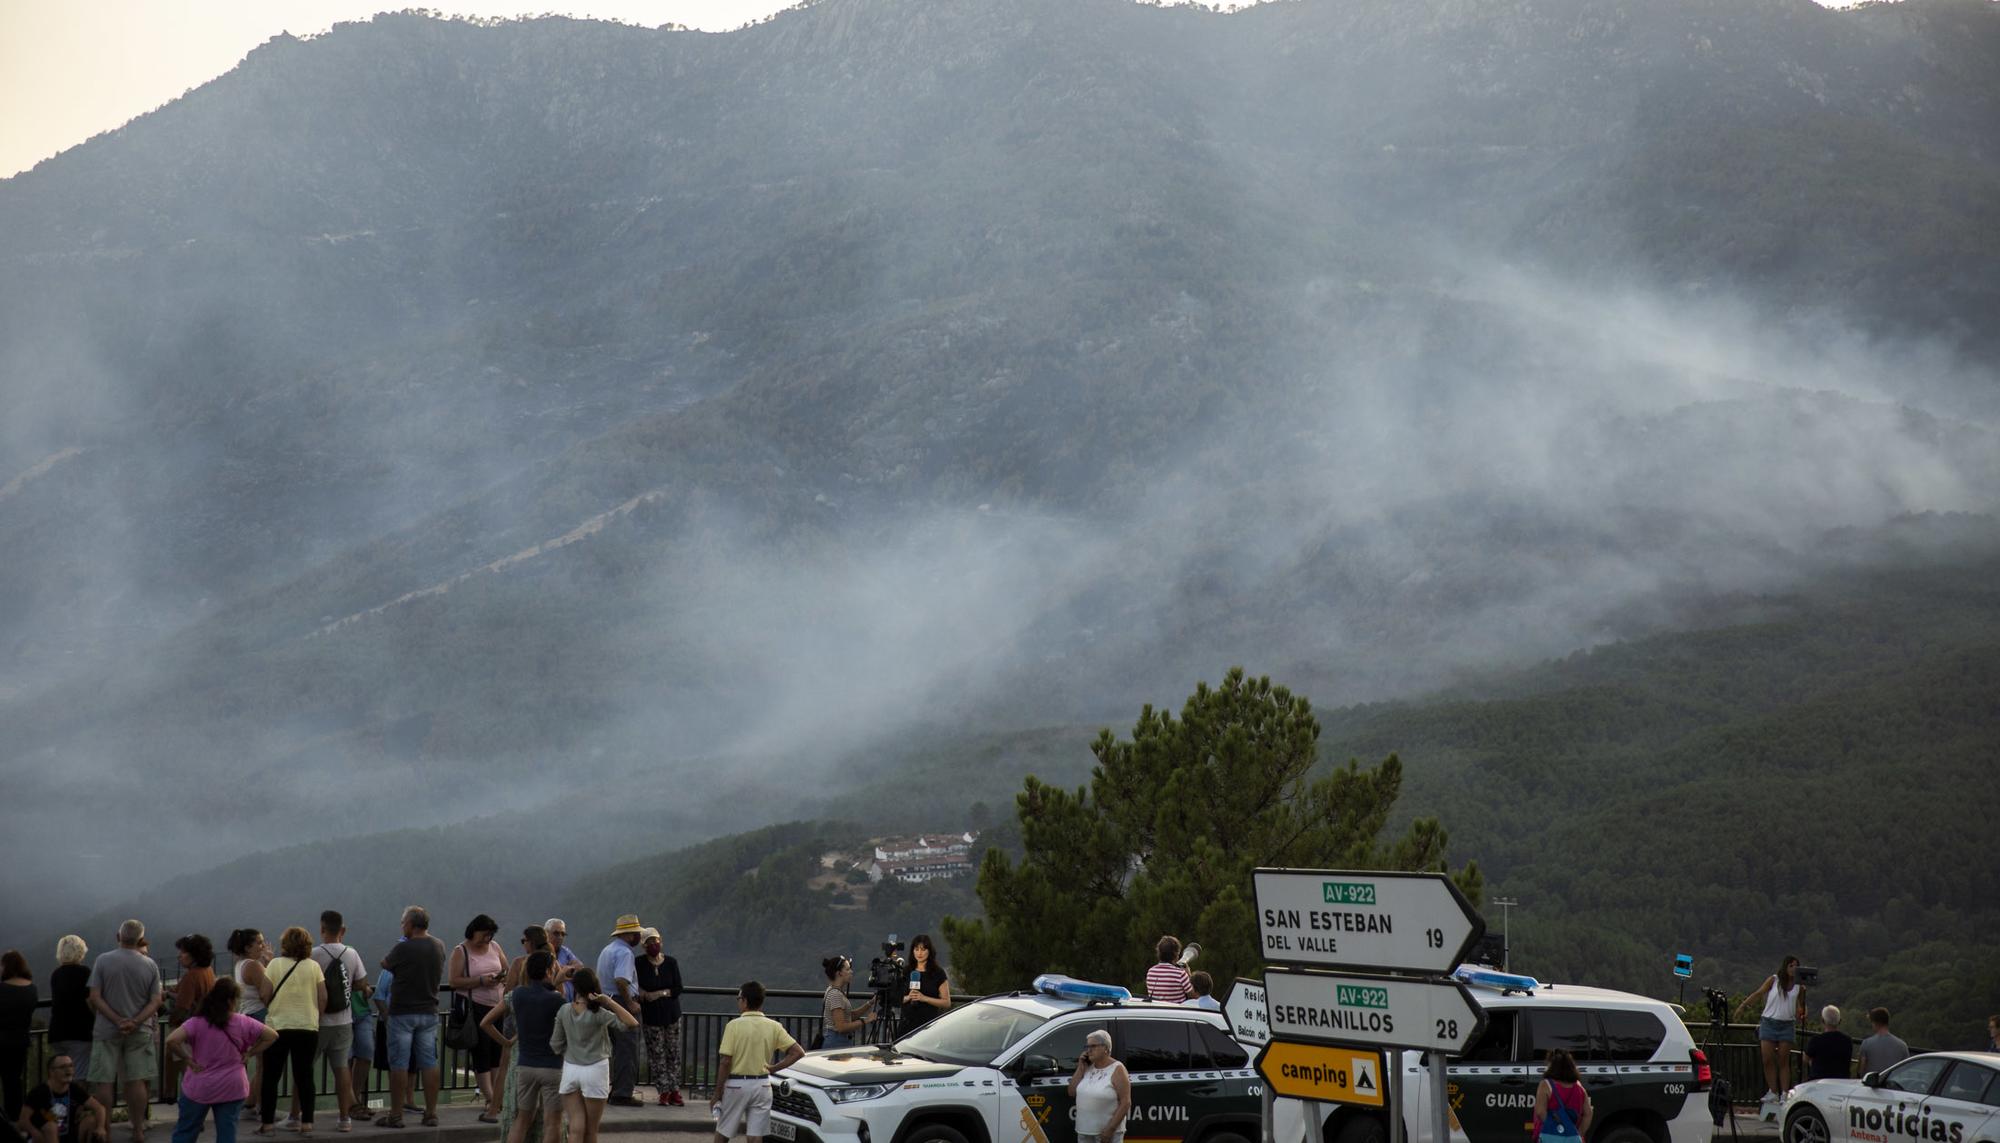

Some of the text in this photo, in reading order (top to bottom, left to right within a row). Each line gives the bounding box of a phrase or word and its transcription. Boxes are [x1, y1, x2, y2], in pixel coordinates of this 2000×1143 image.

[1325, 885, 1374, 902] AV-922
[1265, 909, 1392, 934] SAN ESTEBAN
[1267, 935, 1337, 953] DEL VALLE
[1426, 928, 1444, 949] 19
[1244, 988, 1265, 1003] Resid
[1339, 988, 1387, 1006] AV-922
[1244, 1008, 1253, 1020] de
[1275, 1005, 1394, 1033] SERRANILLOS
[1238, 1024, 1267, 1041] Balcón del
[1436, 1019, 1458, 1040] 28
[1281, 1063, 1347, 1088] camping
[1485, 1093, 1537, 1108] GUARD
[1147, 1105, 1190, 1121] CIVIL
[1849, 1102, 1964, 1143] noticias
[1850, 1128, 1881, 1142] Antena
